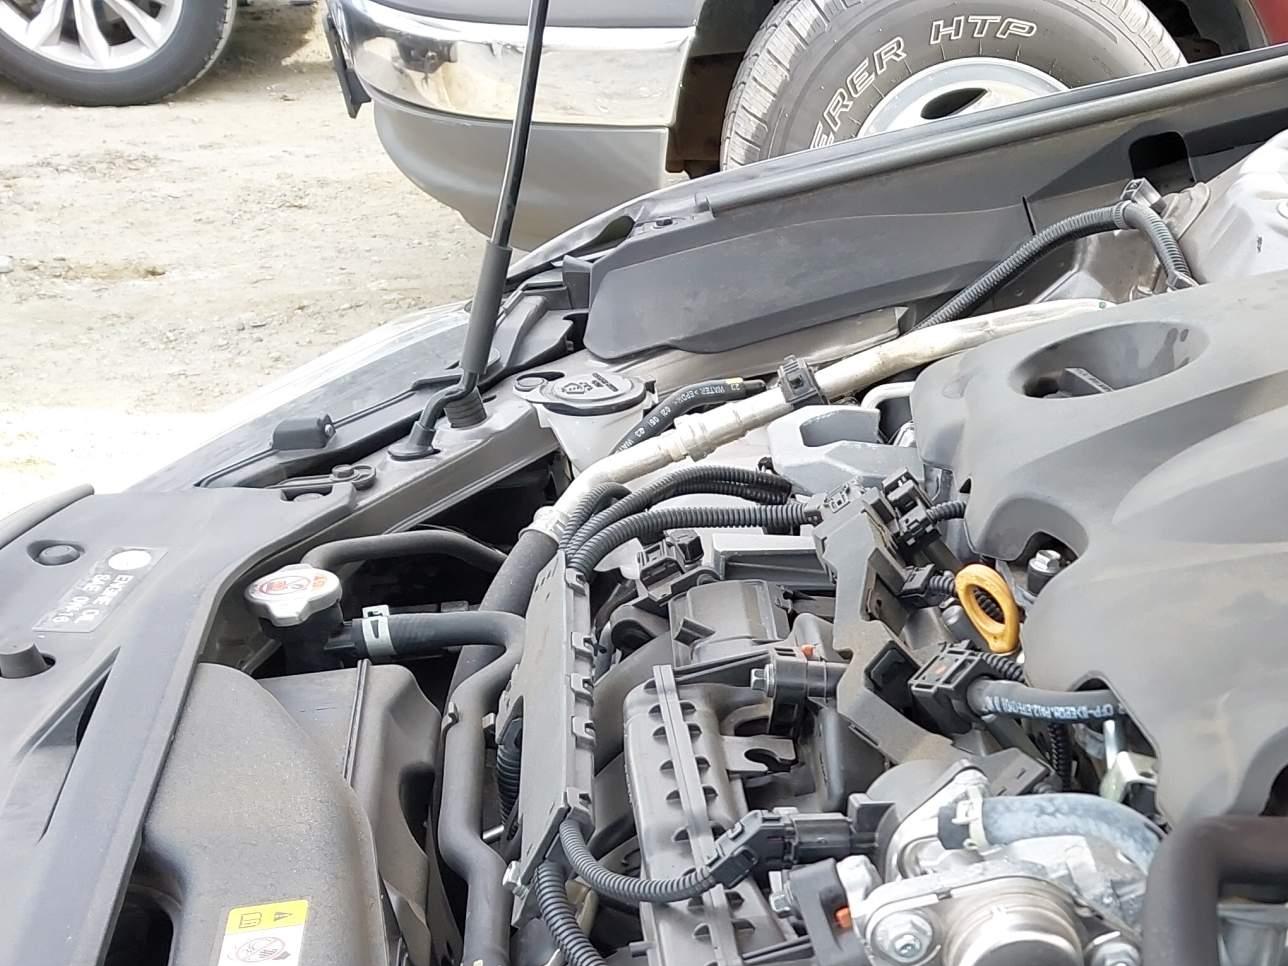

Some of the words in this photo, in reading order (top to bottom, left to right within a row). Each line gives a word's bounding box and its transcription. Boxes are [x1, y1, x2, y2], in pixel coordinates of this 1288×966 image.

[930, 15, 1038, 45] HTP
[93, 574, 135, 606] ENGINE
[73, 609, 100, 624] OIL
